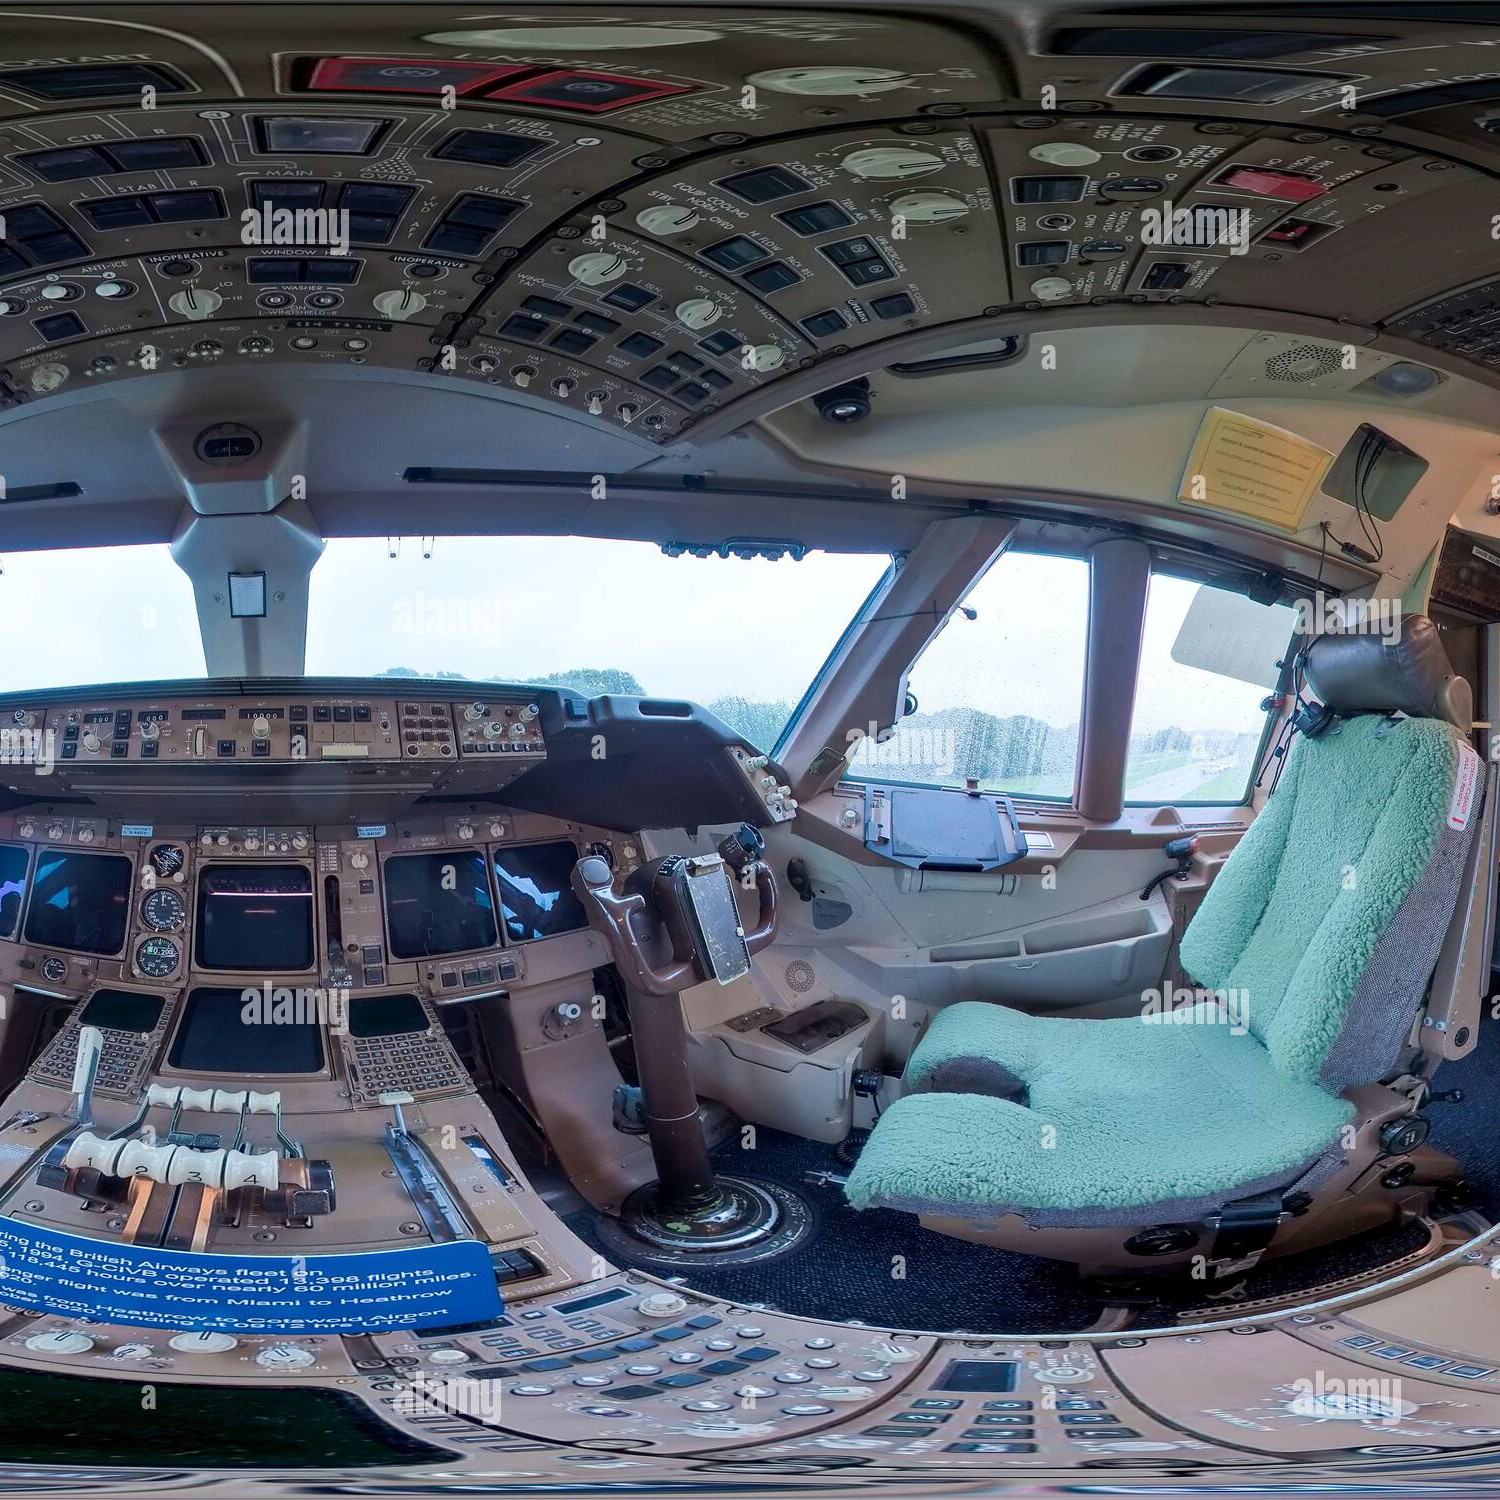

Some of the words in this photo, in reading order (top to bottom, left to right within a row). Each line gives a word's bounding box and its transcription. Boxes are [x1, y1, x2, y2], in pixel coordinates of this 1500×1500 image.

[506, 118, 550, 130] FUEL
[507, 126, 554, 137] FEED
[66, 134, 106, 144] CTR
[361, 172, 409, 181] OVRD
[117, 183, 159, 193] STAB
[475, 185, 516, 197] MAIN
[647, 189, 678, 203] STBY
[672, 182, 707, 198] EQUIP
[705, 193, 750, 220] COOLING
[688, 196, 721, 213] NORM
[708, 216, 735, 231] OVRD
[582, 236, 603, 247] OFF
[608, 240, 639, 256] NORM
[149, 250, 224, 263] INOPERATIVE
[393, 255, 466, 269] INOPERATIVE
[81, 261, 129, 274] ANTI-ICE
[181, 278, 200, 286] OFF
[219, 280, 235, 288] LO
[401, 279, 420, 287] OFF
[516, 271, 546, 285] WING
[21, 285, 38, 295] OFF
[87, 1156, 93, 1167] 1
[135, 1166, 148, 1175] 2
[188, 1171, 202, 1182] 3
[244, 1174, 259, 1186] 4
[35, 1240, 63, 1253] the
[69, 1248, 132, 1266] British
[138, 1261, 228, 1276] Airways
[235, 1268, 287, 1277] fleet
[76, 1259, 158, 1277] G-CIVB
[165, 1274, 269, 1286] operated
[367, 1268, 435, 1282] flights
[87, 1268, 147, 1284] hours
[153, 1279, 205, 1290] over
[211, 1284, 287, 1294] nearly
[293, 1285, 324, 1293] 60
[332, 1279, 407, 1292] million
[414, 1271, 477, 1285] miles.
[57, 1278, 107, 1293] flight
[113, 1288, 159, 1299] was
[164, 1294, 218, 1304] from
[227, 1298, 301, 1306] Miami
[341, 1289, 453, 1304] Heathrow
[1, 1285, 38, 1299] was
[43, 1294, 88, 1308] from
[95, 1304, 208, 1321] Heathrow
[246, 1316, 363, 1324] Cotswold
[369, 1309, 449, 1322] Airport
[109, 1312, 195, 1326] landing
[362, 1318, 418, 1327] UTC
